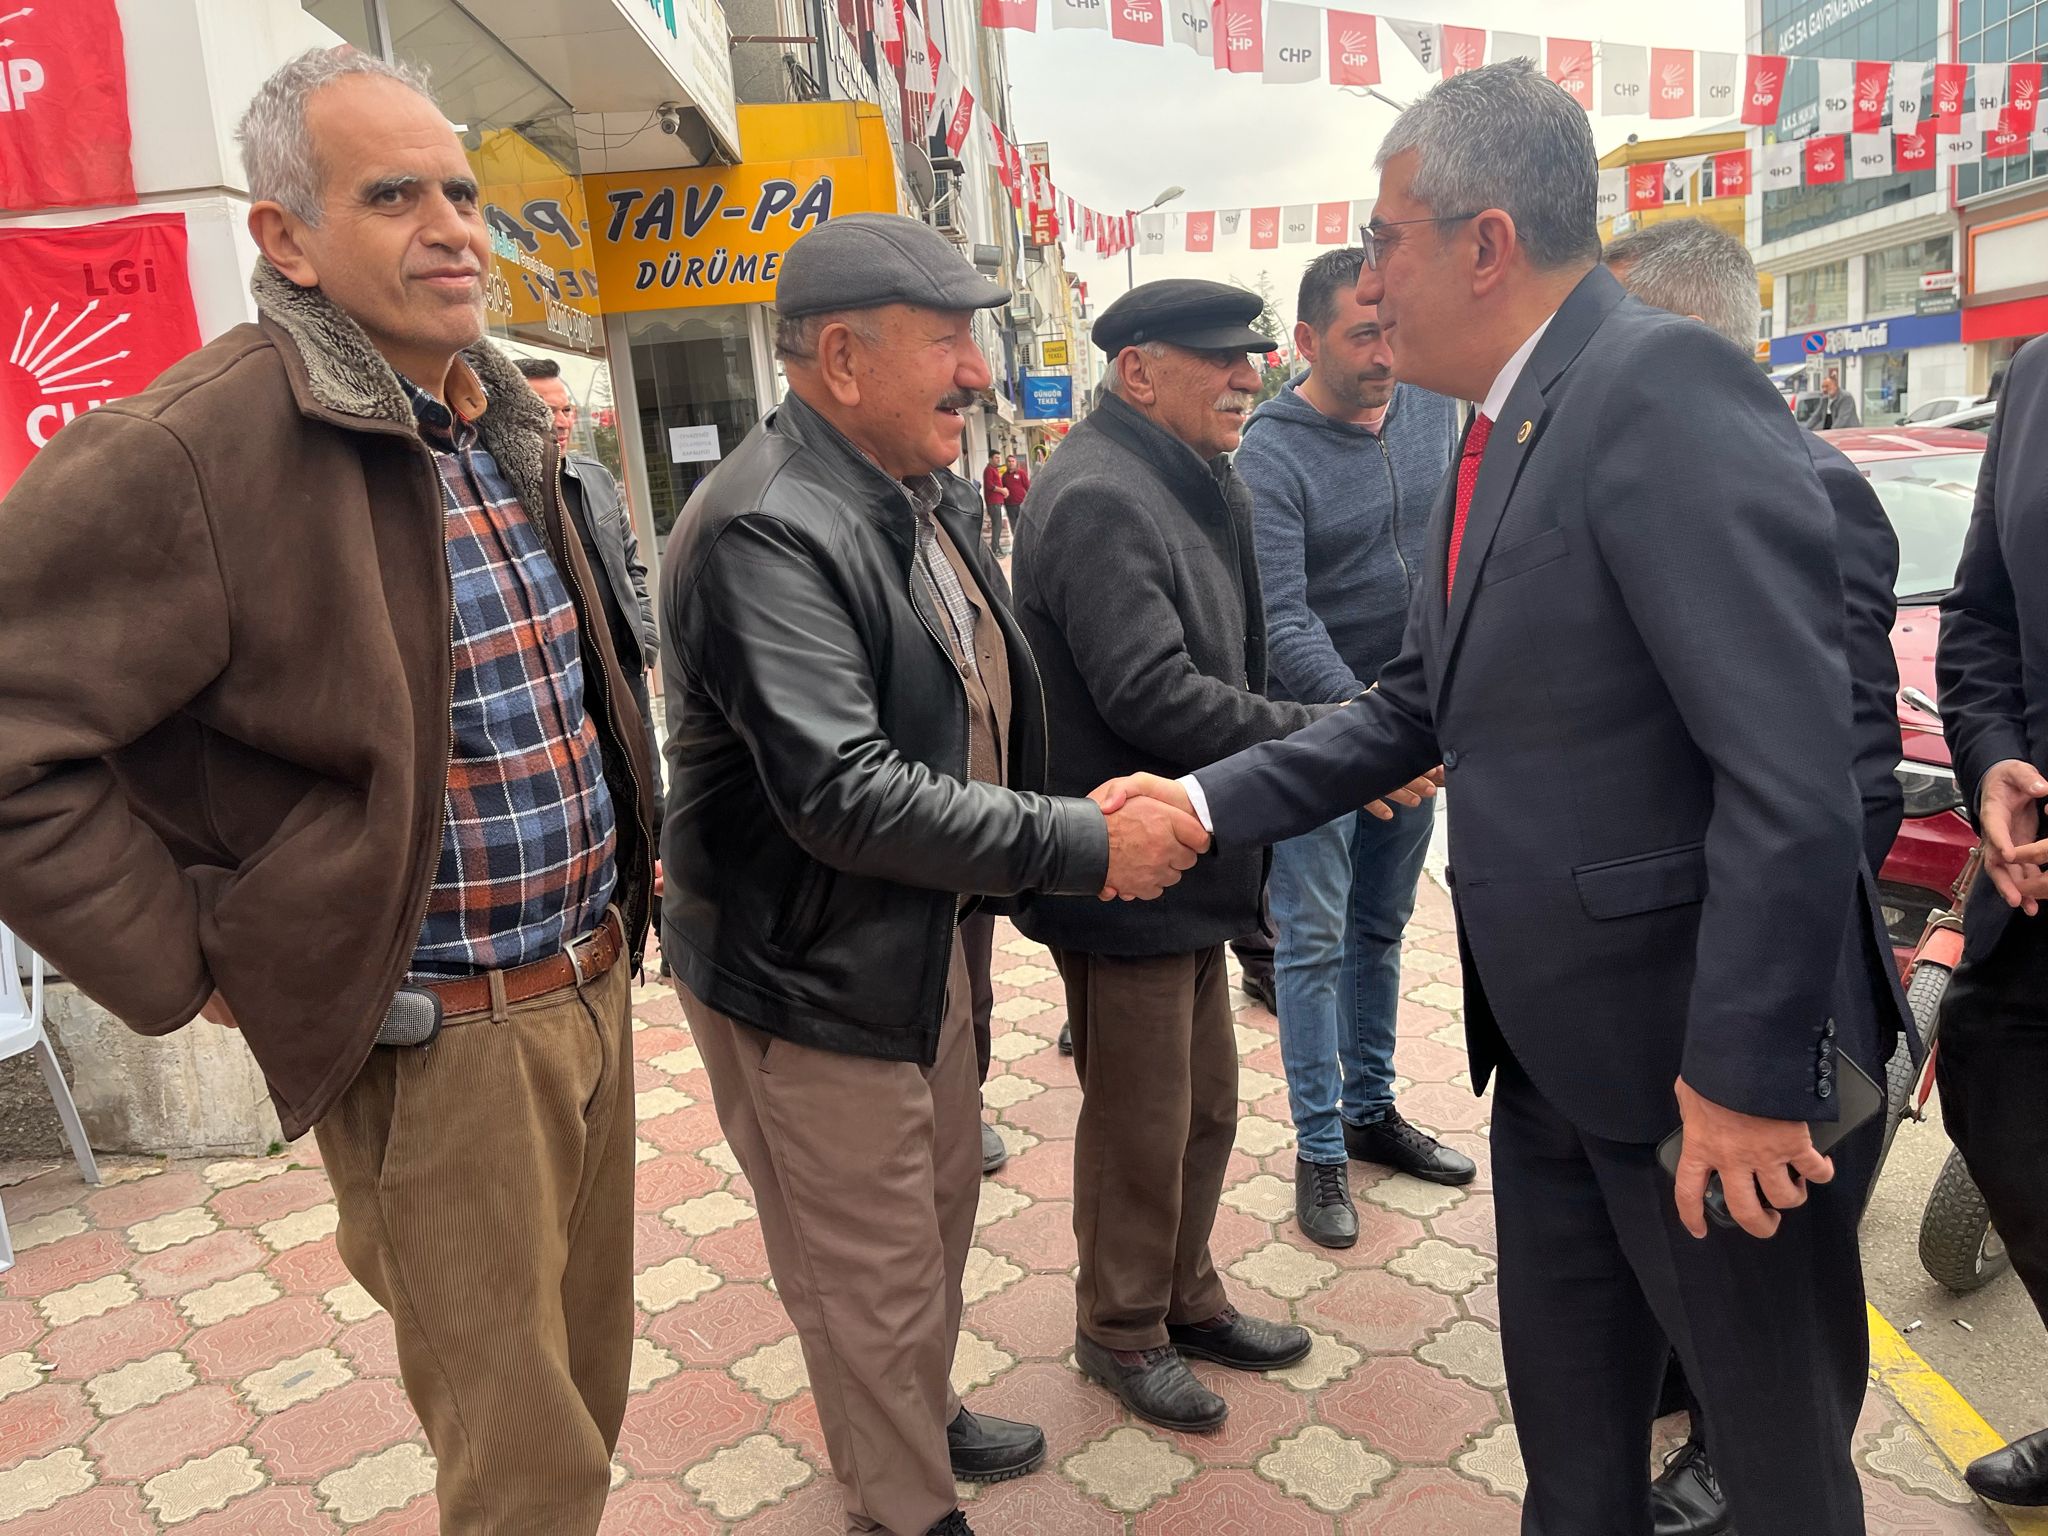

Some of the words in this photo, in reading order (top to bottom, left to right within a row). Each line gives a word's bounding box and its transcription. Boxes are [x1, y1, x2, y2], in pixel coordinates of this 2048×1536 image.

[1123, 8, 1153, 23] CHP
[1182, 12, 1208, 33] CHP
[909, 49, 925, 65] HP
[1279, 47, 1312, 63] CHP
[1341, 53, 1368, 66] CHP
[1614, 83, 1640, 97] CHP
[1661, 87, 1685, 100] CHP
[1709, 86, 1731, 98] CHP
[1752, 93, 1774, 106] CHP
[607, 175, 833, 244] TAV-PA
[635, 248, 783, 290] DÜRÜME
[1033, 389, 1062, 398] GÜNGÖR
[1037, 397, 1059, 405] TEKEL
